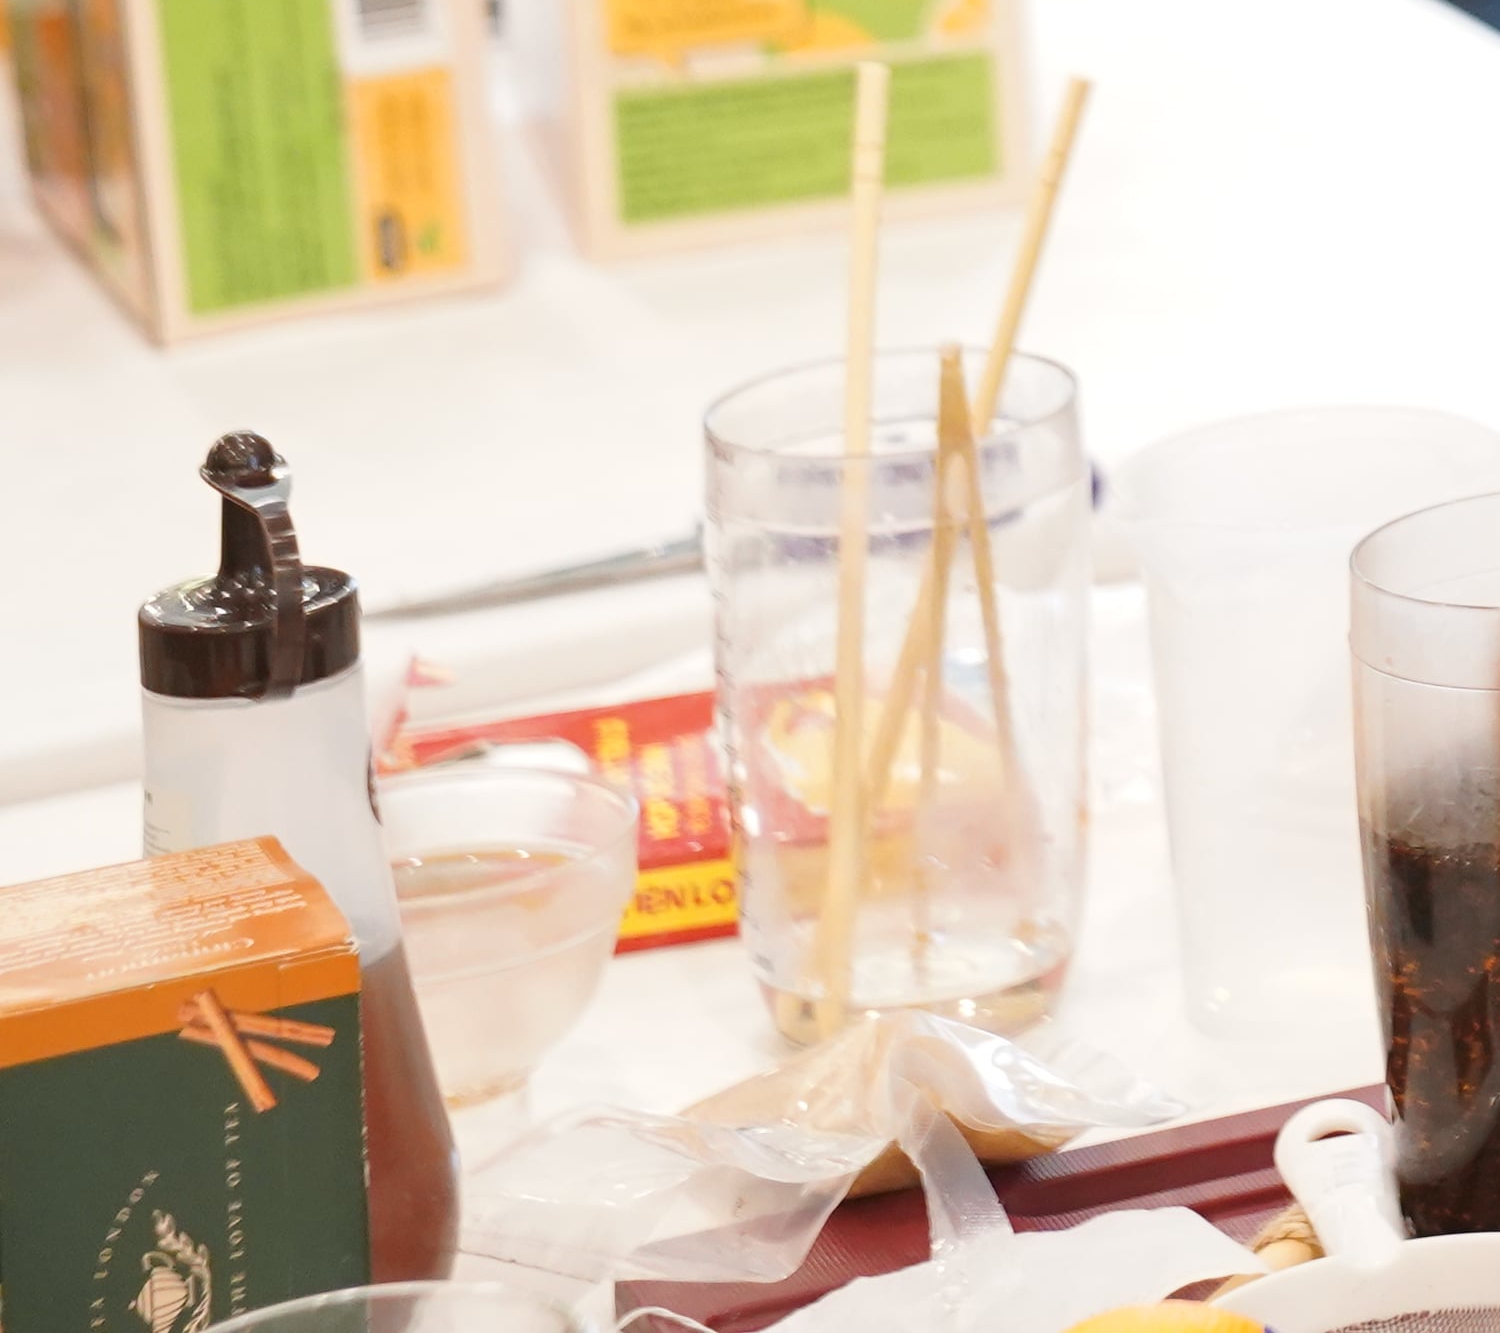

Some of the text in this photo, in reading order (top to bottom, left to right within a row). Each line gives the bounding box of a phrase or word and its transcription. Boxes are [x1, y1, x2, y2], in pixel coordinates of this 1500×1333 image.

[223, 1101, 241, 1147] TEA
[225, 1159, 242, 1189] OF
[93, 1169, 160, 1280] LONDON
[227, 1200, 246, 1261] LOVE
